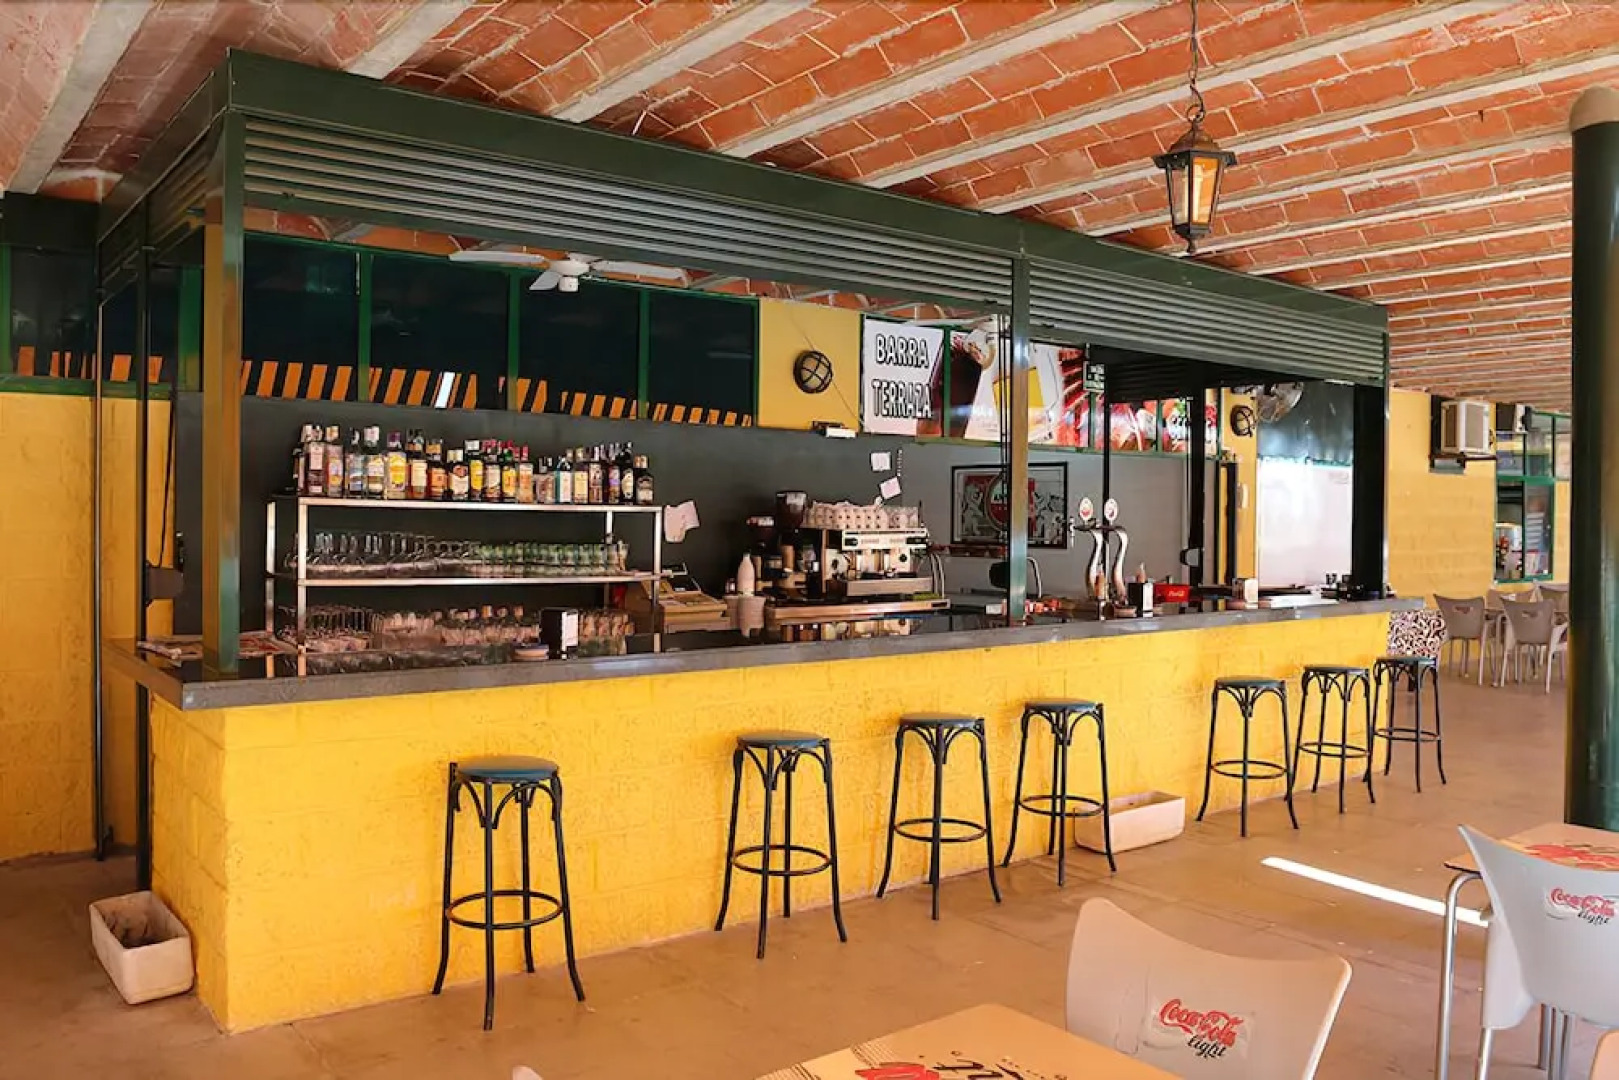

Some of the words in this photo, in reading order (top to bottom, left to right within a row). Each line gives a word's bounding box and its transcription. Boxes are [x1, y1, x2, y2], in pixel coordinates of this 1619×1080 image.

[875, 333, 930, 369] BARRA
[871, 378, 932, 419] TERRAZA
[1186, 1034, 1227, 1059] light
